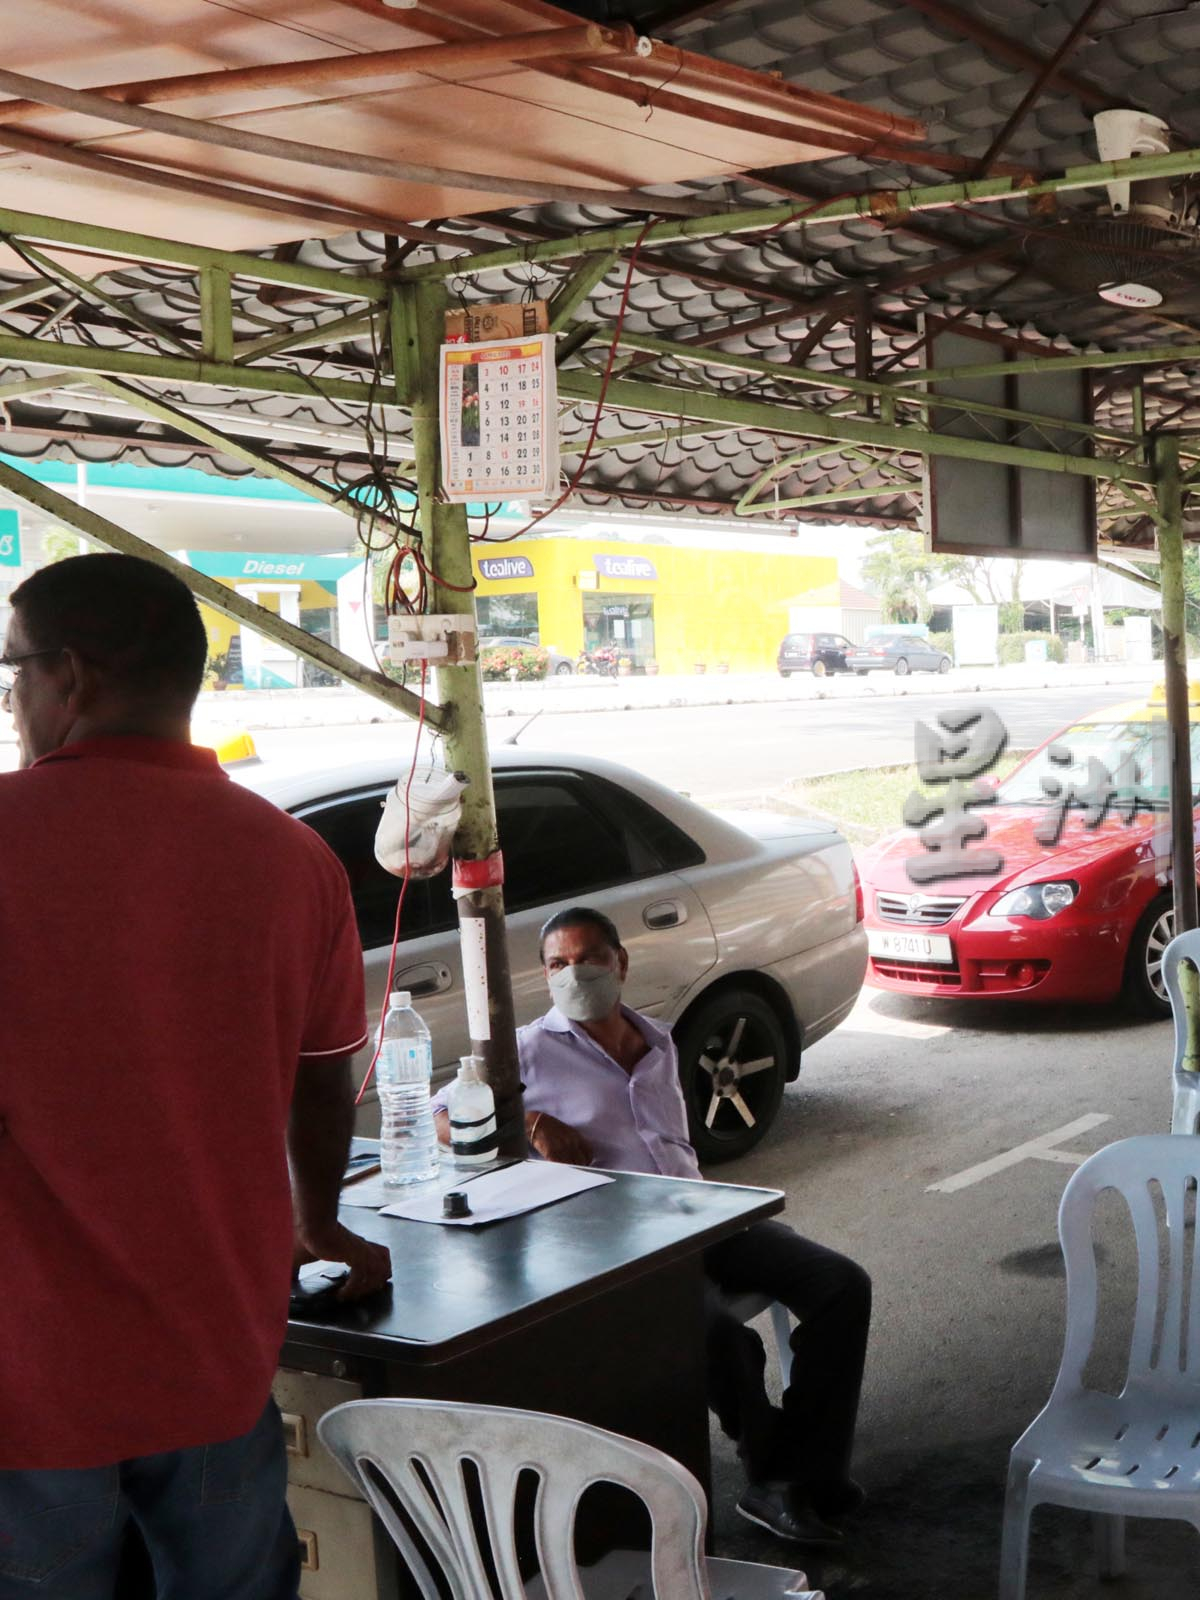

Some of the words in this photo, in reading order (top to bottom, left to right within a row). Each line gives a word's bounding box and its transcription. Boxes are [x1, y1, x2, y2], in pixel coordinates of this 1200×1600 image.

[499, 365, 509, 375] 10
[518, 363, 526, 374] 17
[501, 382, 509, 391] 11
[518, 380, 527, 390] 18
[500, 399, 510, 409] 12
[500, 416, 510, 426] 13
[516, 415, 527, 424] 20
[500, 433, 509, 442] 14
[517, 432, 527, 441] 21
[517, 448, 527, 458] 22
[501, 466, 509, 476] 16
[516, 465, 527, 475] 23
[242, 559, 305, 575] Diesel
[483, 560, 527, 577] tealive
[605, 558, 652, 577] tealive
